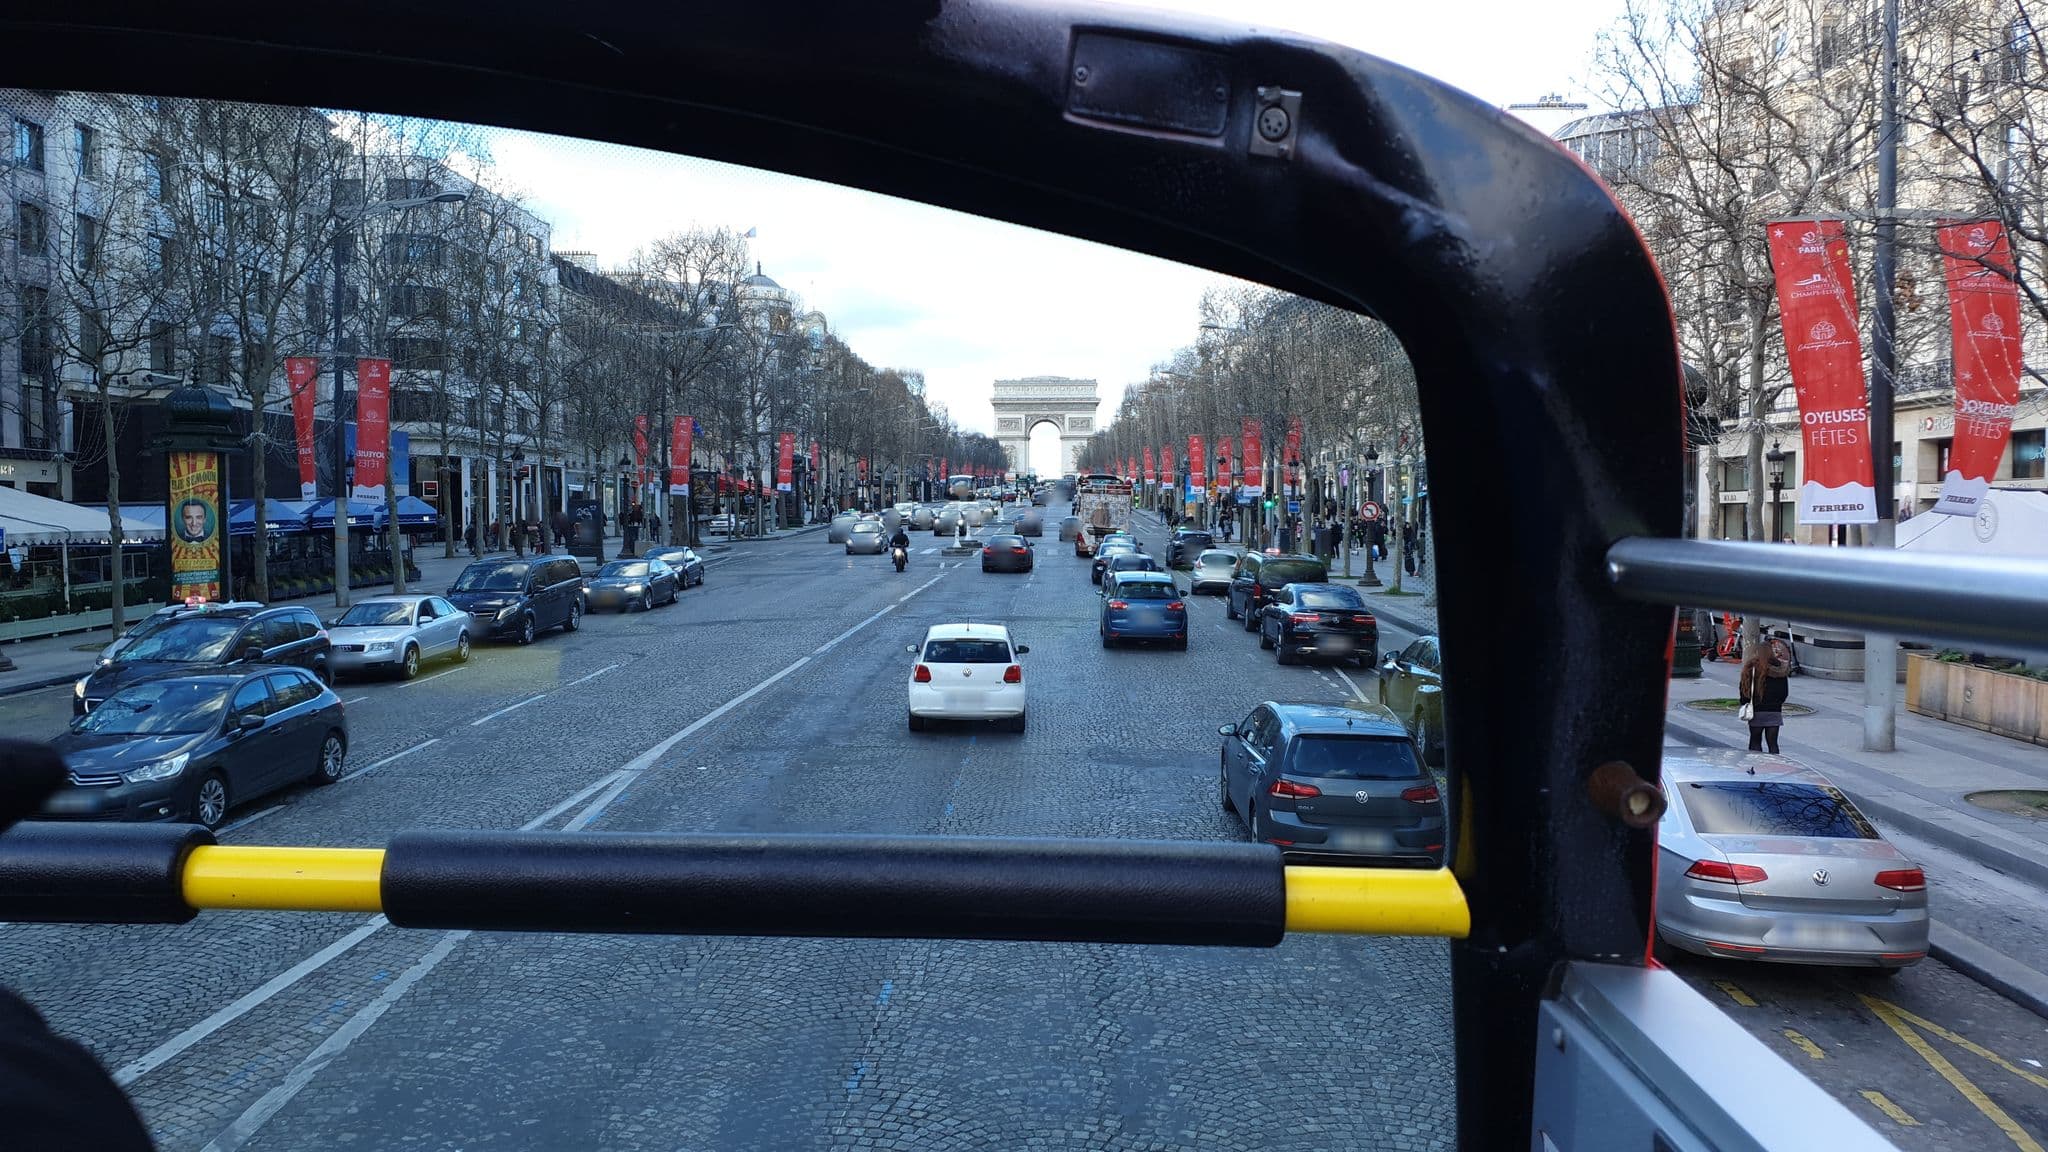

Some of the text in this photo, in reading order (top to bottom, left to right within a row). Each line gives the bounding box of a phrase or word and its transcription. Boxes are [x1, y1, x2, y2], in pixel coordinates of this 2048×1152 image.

[1798, 246, 1826, 254] PARIS
[1804, 408, 1866, 425] OYEUSES
[1811, 427, 1858, 446] FÊTES
[186, 470, 216, 487] SEMOUN
[1812, 503, 1864, 512] FERRERO
